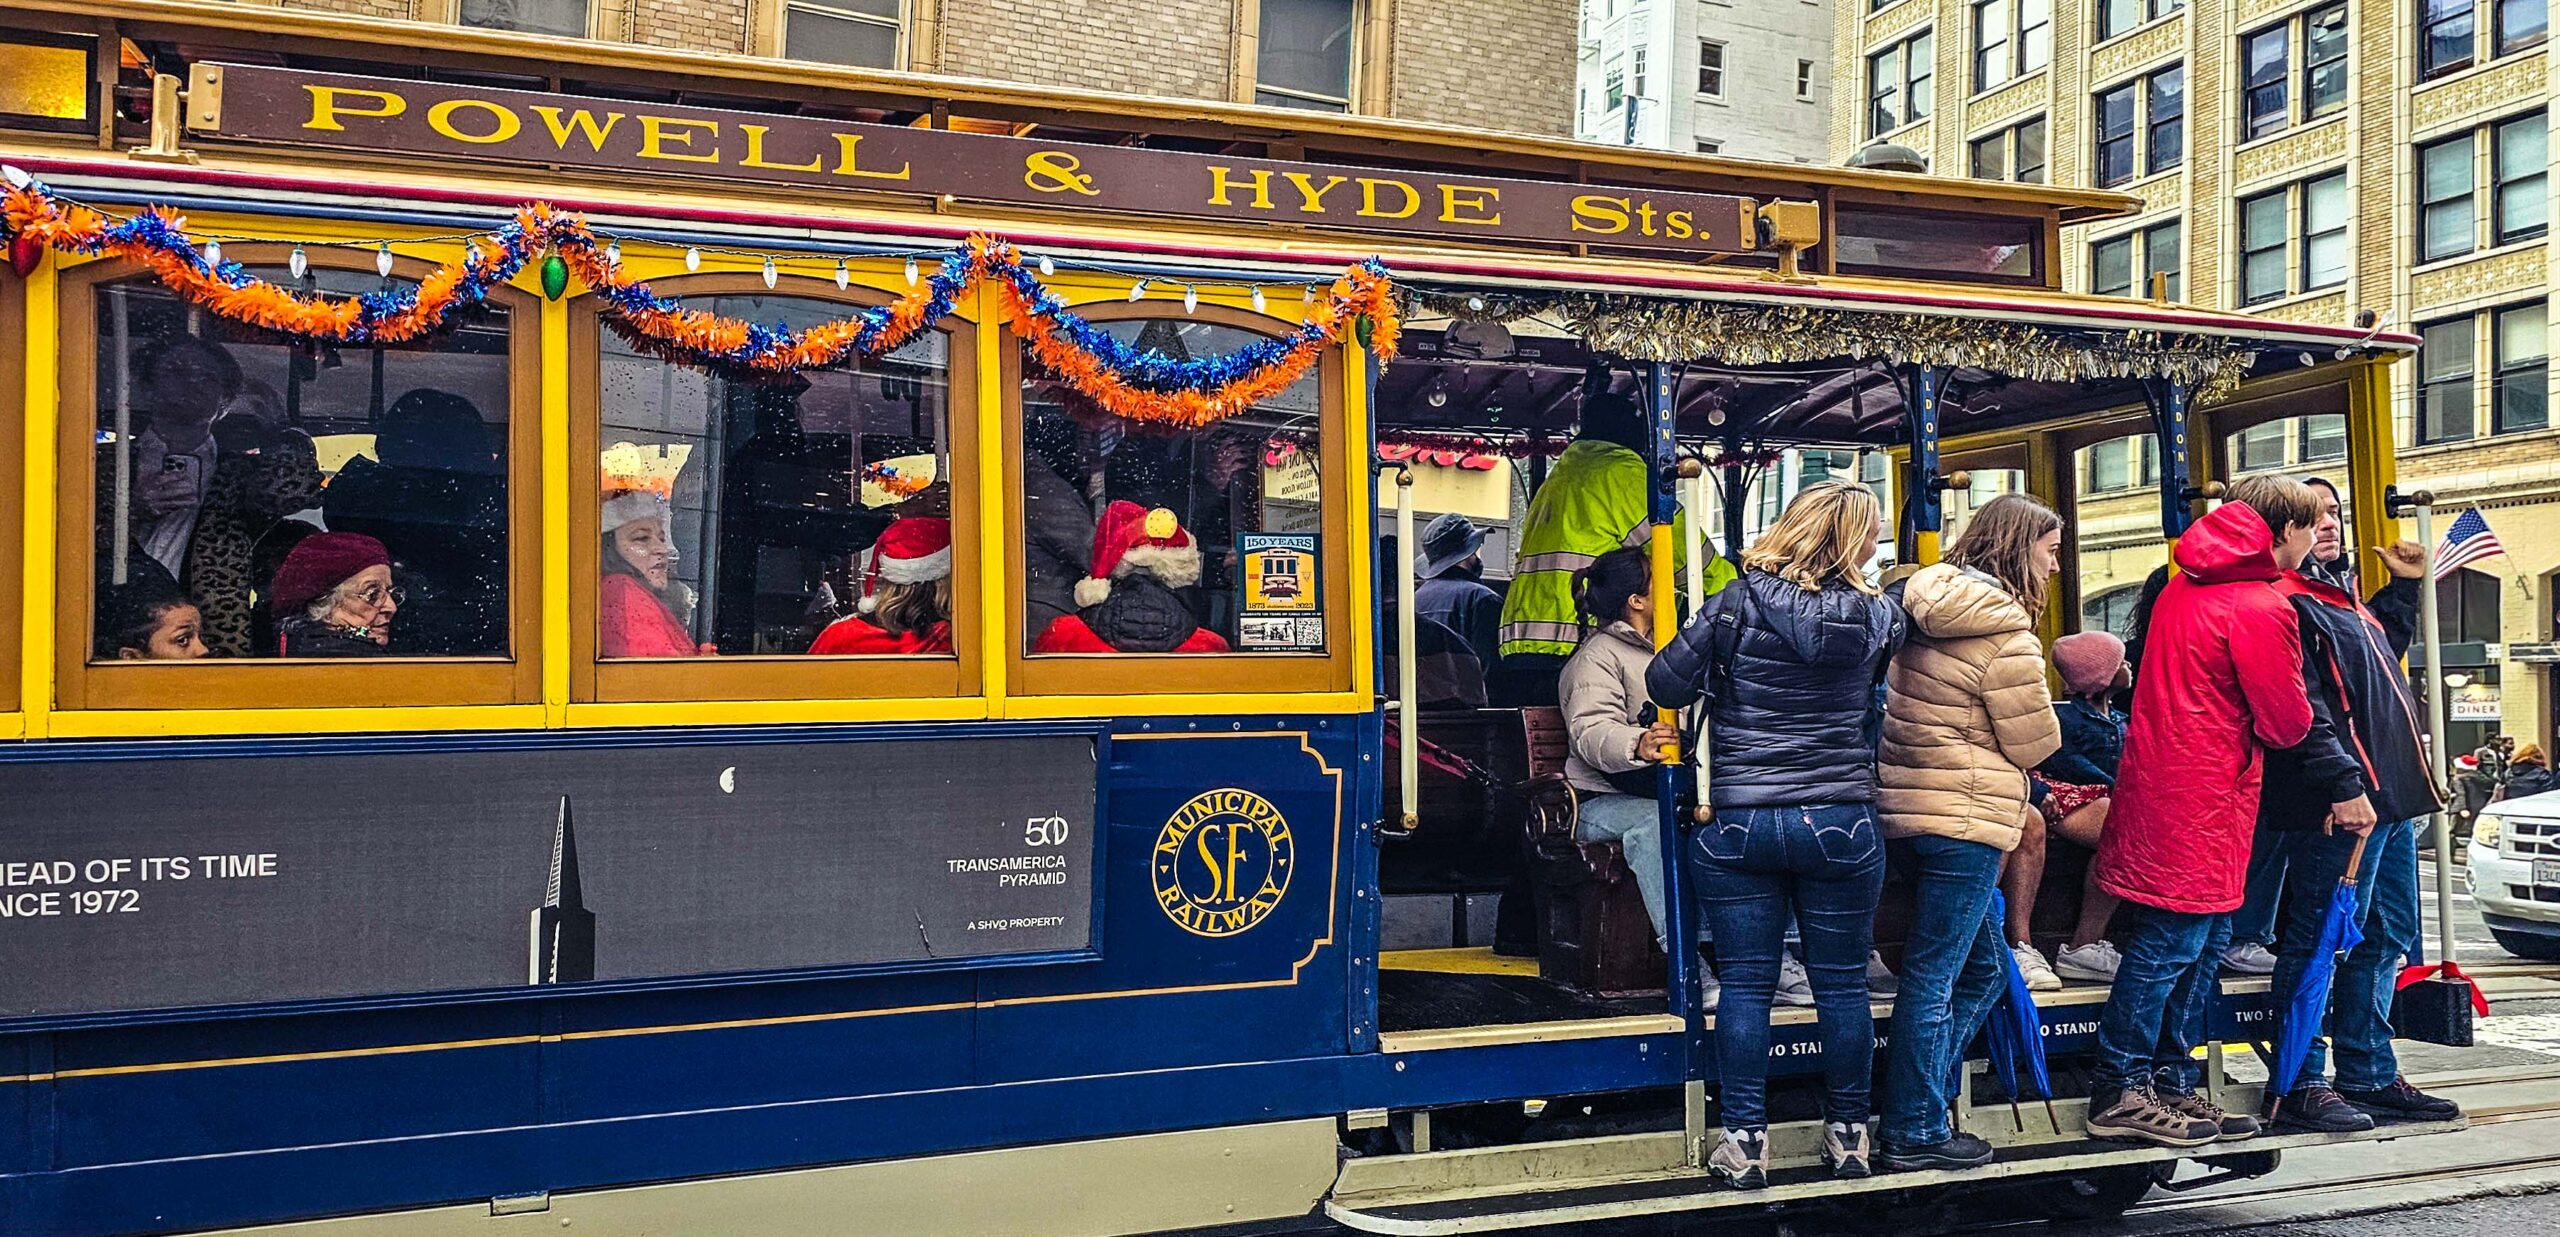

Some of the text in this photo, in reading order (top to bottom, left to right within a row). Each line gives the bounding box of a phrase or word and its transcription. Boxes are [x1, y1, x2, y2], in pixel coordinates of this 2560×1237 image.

[302, 84, 1711, 240] POWELL & HYDE Sts.
[1247, 538, 1312, 548] 150 YEARS
[2457, 705, 2496, 714] DINER
[1025, 810, 1069, 846] 50
[1158, 792, 1288, 855] MUNICIPAL
[0, 854, 278, 887] EAD OF ITS TIME
[947, 855, 1066, 873] TRANSAMERICA
[1193, 822, 1253, 905] S.F.
[999, 872, 1067, 887] PYRAMID
[69, 889, 140, 914] 1972
[1160, 875, 1281, 932] RAILWAY
[967, 916, 1065, 931] A SHVO PROPERTY
[2235, 1010, 2264, 1023] TWO
[2055, 1021, 2101, 1036] STAND
